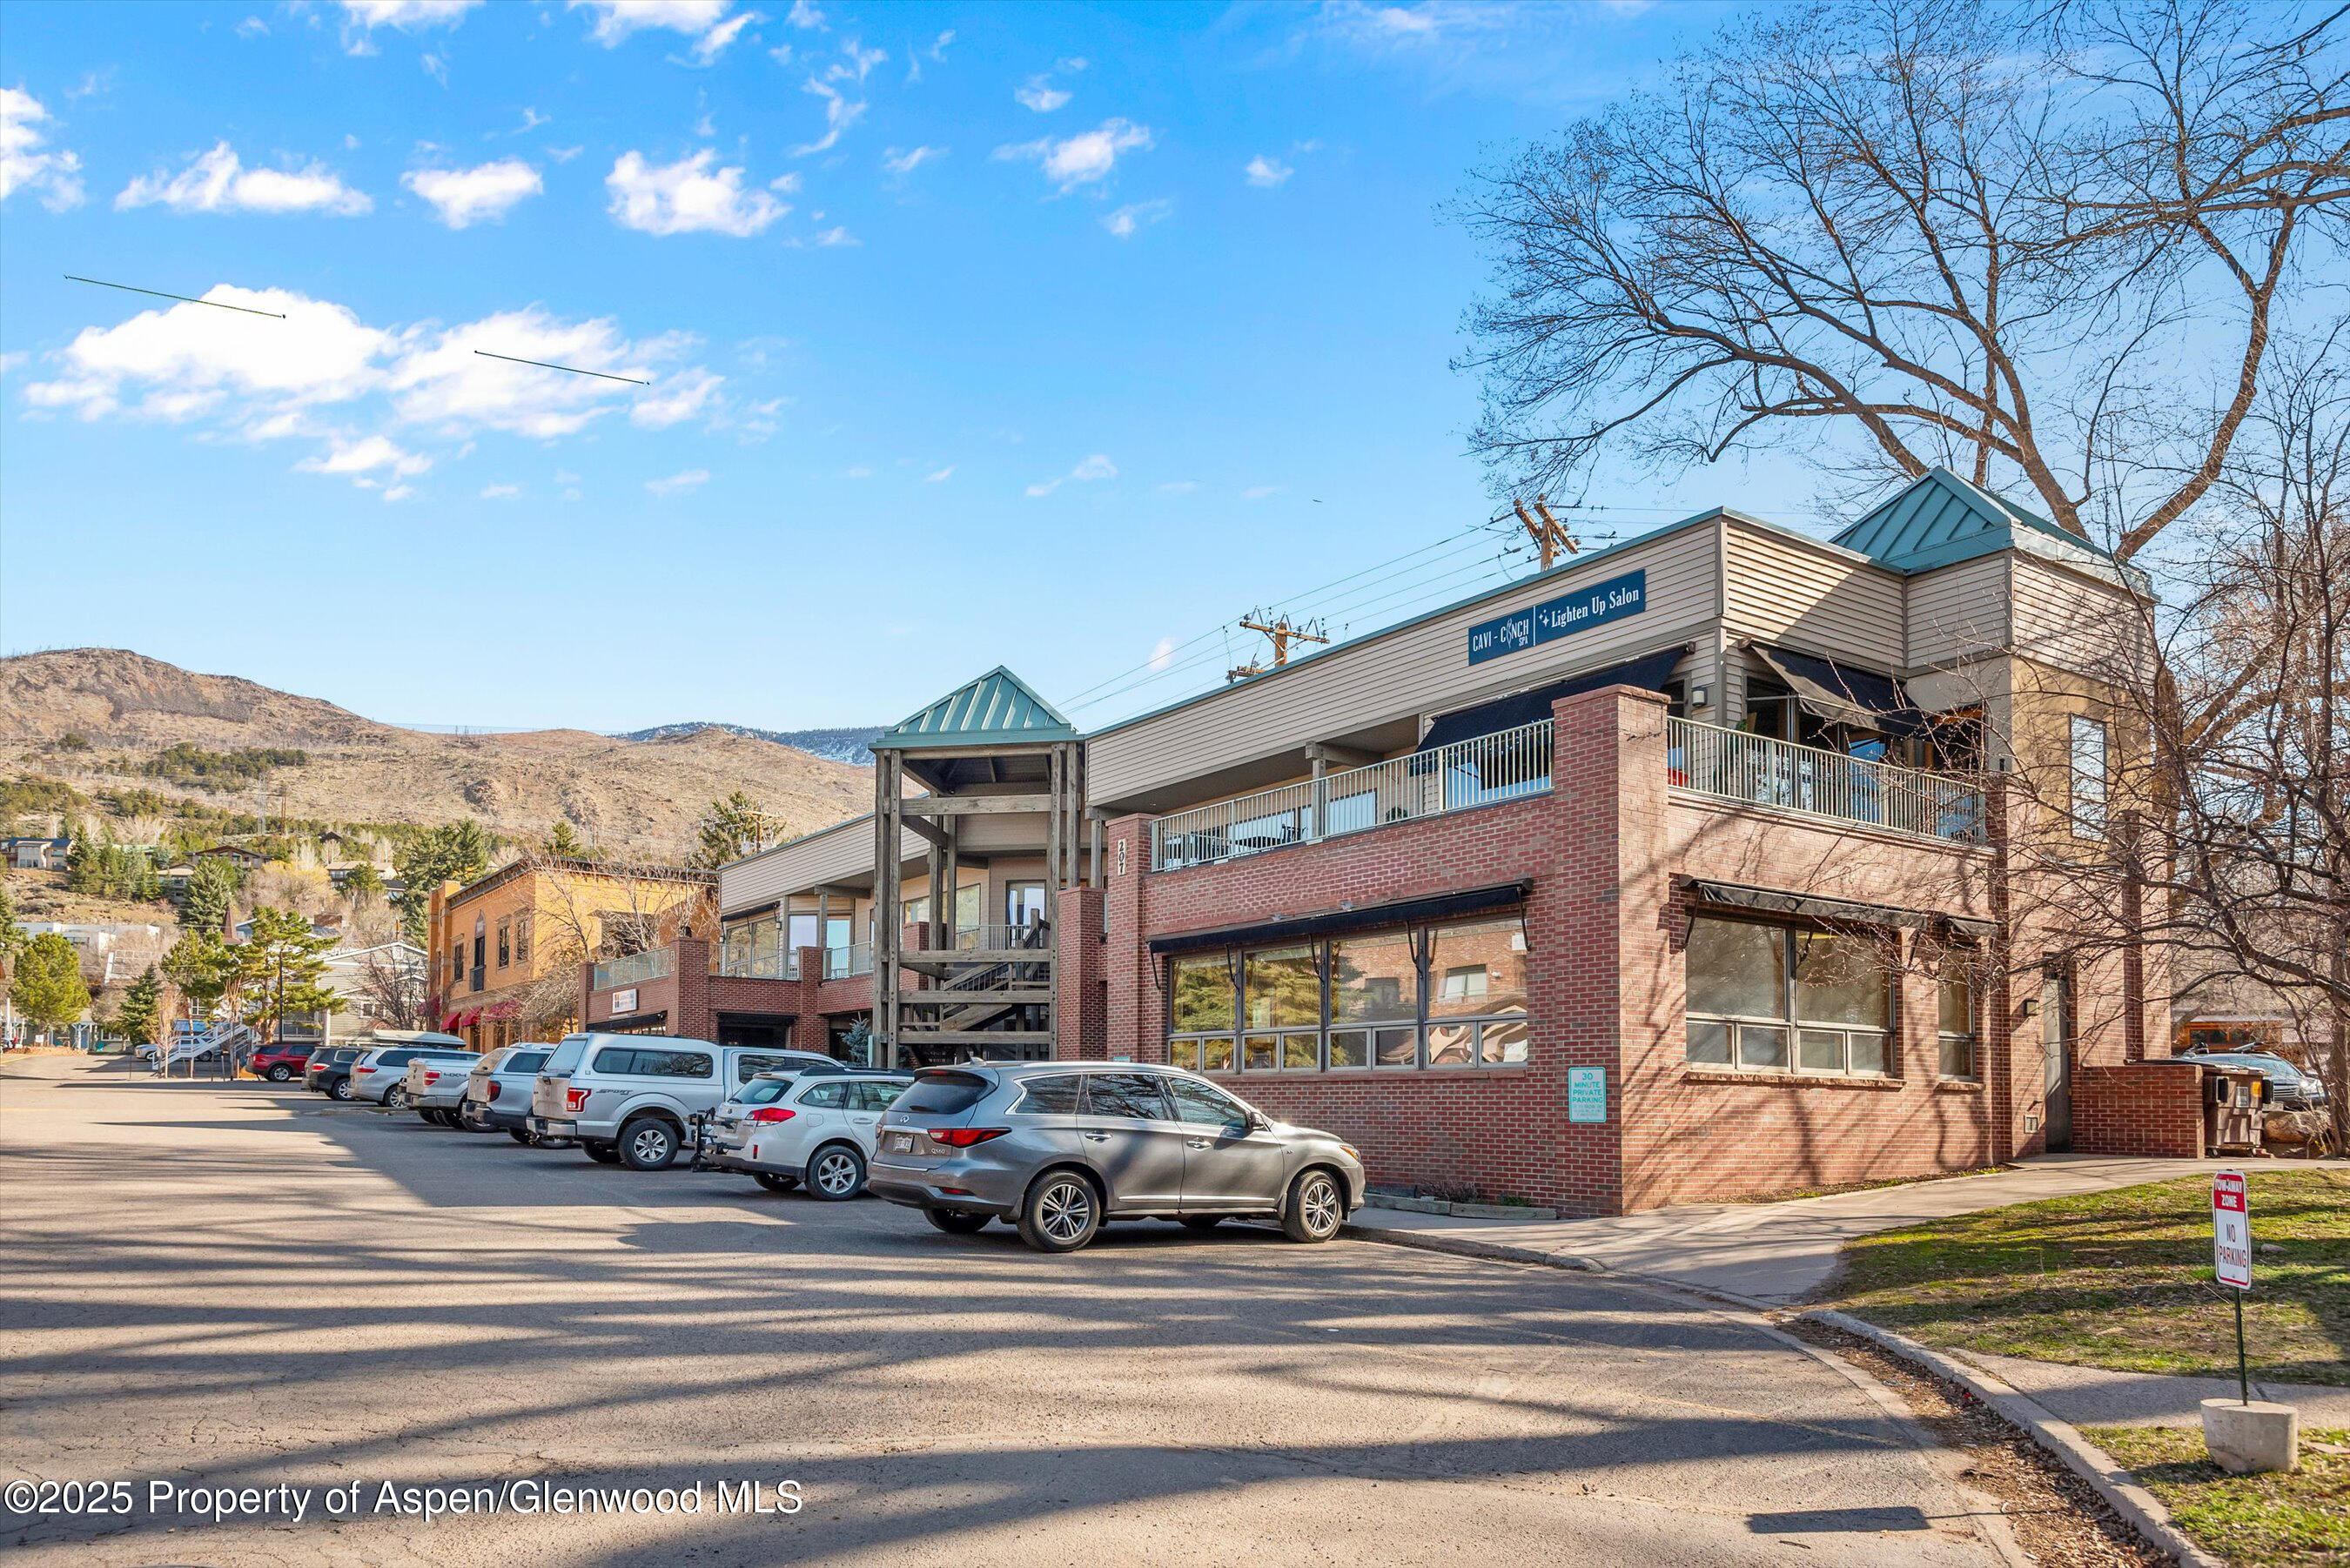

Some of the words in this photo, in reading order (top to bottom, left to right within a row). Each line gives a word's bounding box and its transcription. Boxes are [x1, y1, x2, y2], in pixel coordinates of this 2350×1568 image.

[1551, 606, 1588, 628] Lighten
[1592, 595, 1606, 615] Up
[1609, 587, 1639, 609] Salon
[1473, 631, 1492, 652] CAVI
[1519, 635, 1528, 647] SPA
[1582, 1072, 1594, 1081] 30
[2221, 1194, 2238, 1209] ZONE
[2226, 1223, 2236, 1243] NO
[2219, 1244, 2246, 1268] PARKING
